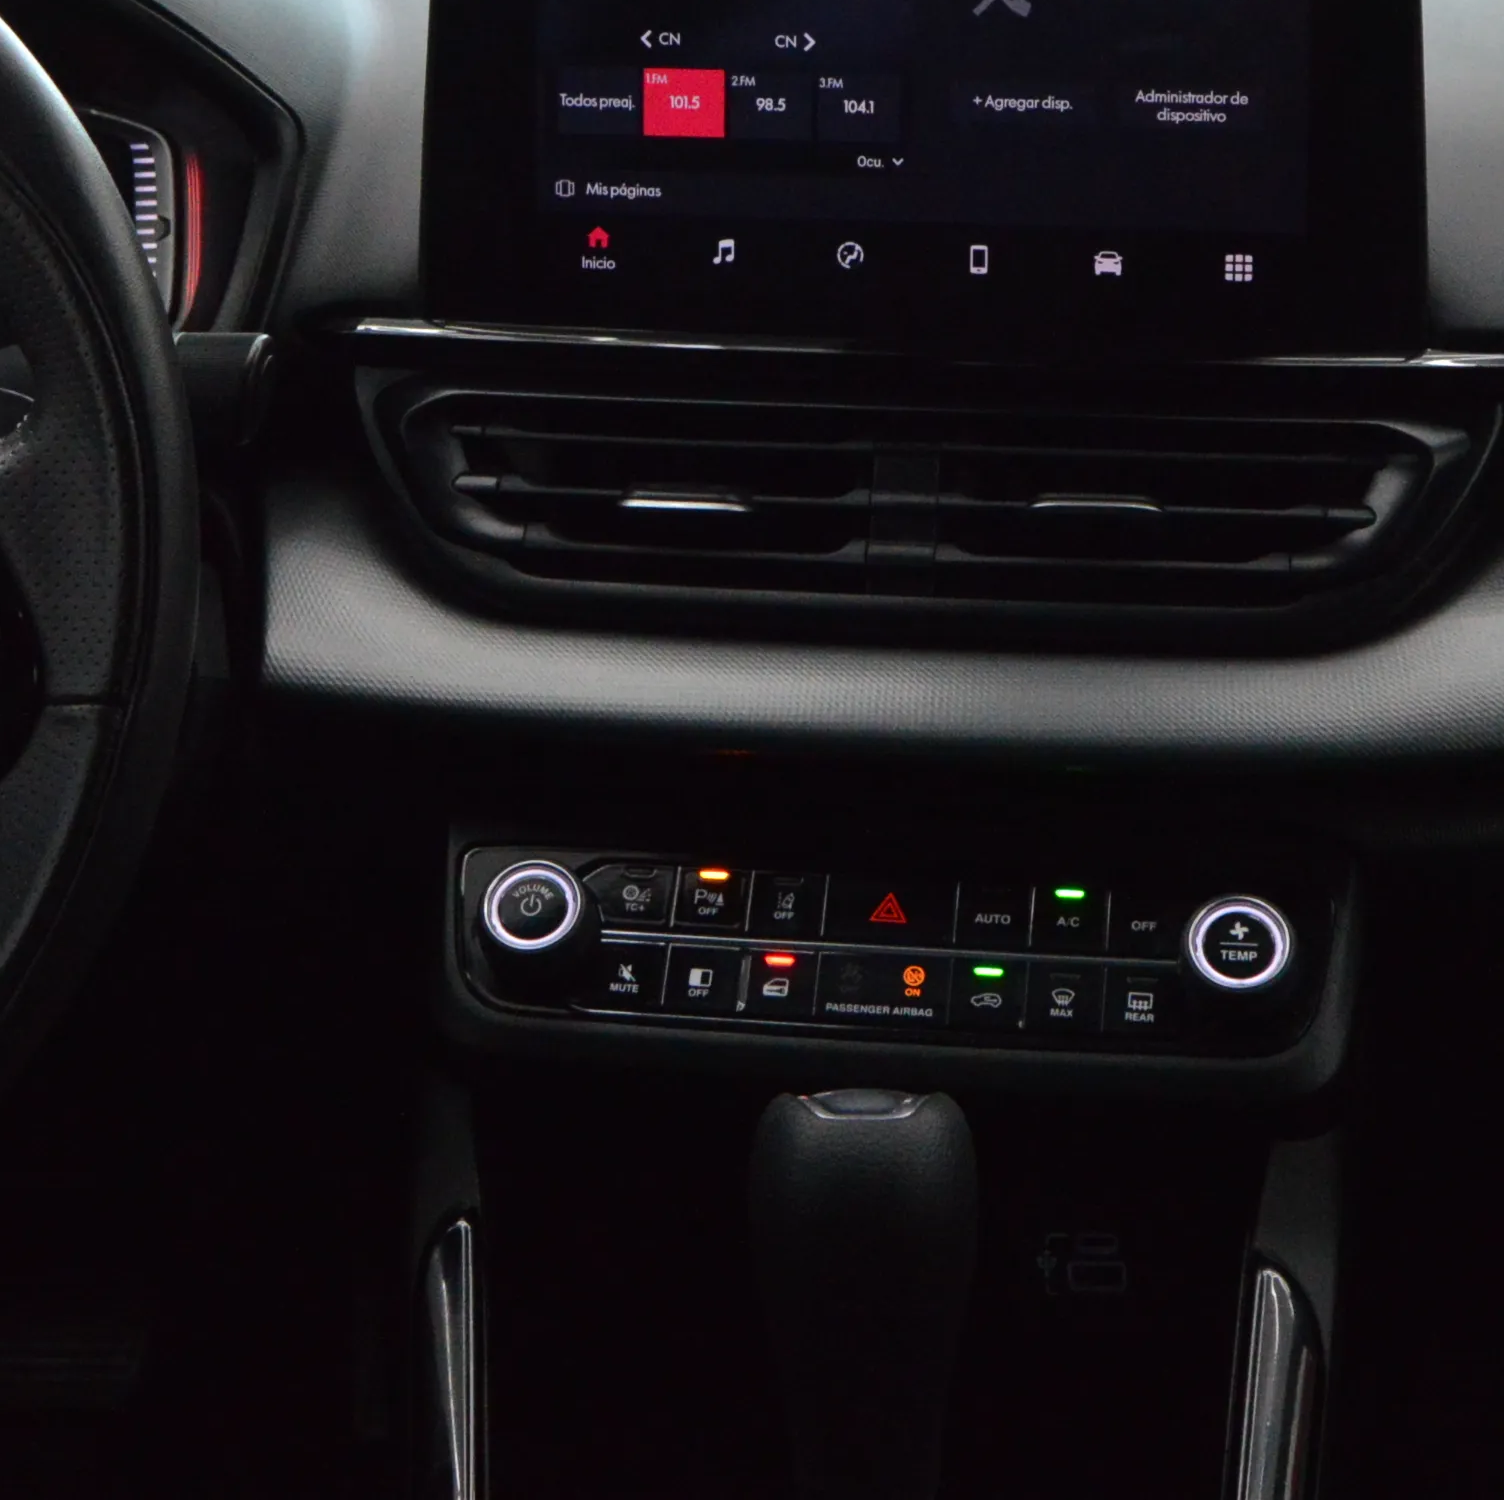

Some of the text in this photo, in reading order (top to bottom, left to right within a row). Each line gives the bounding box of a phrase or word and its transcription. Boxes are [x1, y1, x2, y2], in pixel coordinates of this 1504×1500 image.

[659, 32, 680, 45] CN
[775, 35, 796, 48] CN
[732, 76, 755, 86] 2.FM
[820, 78, 843, 88] 3.FM
[560, 93, 635, 111] Todos preaj.
[669, 95, 701, 110] 101.5
[1136, 89, 1249, 105] Administrador de
[756, 98, 785, 111] 98.5
[844, 100, 874, 113] 104.1
[985, 95, 1039, 111] Agregar
[1042, 96, 1072, 112] disp.
[1157, 108, 1226, 124] dispositivo
[586, 183, 661, 199] Mis páginas
[582, 256, 615, 269] Inicio
[511, 884, 554, 901] VOLUME
[698, 904, 720, 915] OFF
[774, 908, 793, 919] OFF
[975, 914, 1010, 924] AUTO
[1057, 917, 1079, 927] A/C
[1132, 921, 1156, 930] OFF
[1221, 950, 1257, 961] TEMP
[610, 982, 639, 993] MUTE
[687, 988, 710, 999] OFF
[904, 988, 922, 998] ON
[826, 1003, 932, 1016] PASSENGER AIRBAG
[1050, 1006, 1073, 1017] MAX
[1125, 1009, 1154, 1021] REAR
